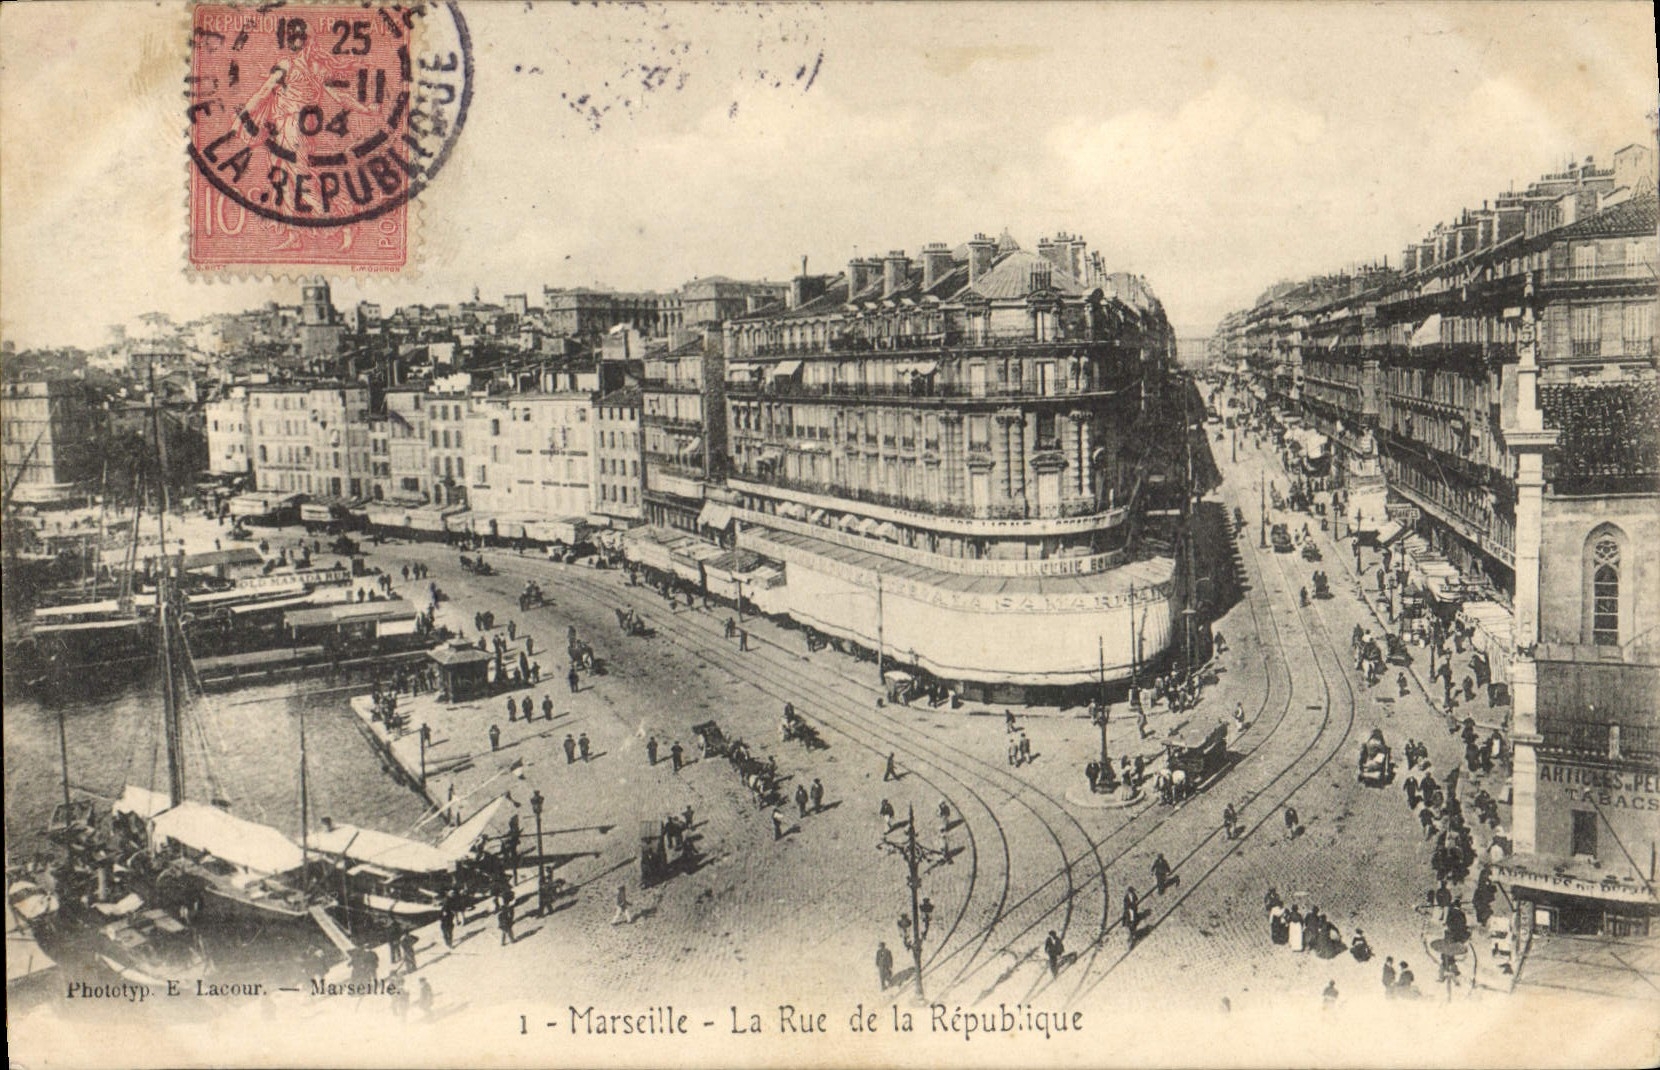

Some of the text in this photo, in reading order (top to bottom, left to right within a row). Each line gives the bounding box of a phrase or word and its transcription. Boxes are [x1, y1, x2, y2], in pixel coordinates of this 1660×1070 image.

[277, 17, 372, 55] 18 25
[300, 105, 350, 138] 04
[1564, 787, 1660, 811] TABACS
